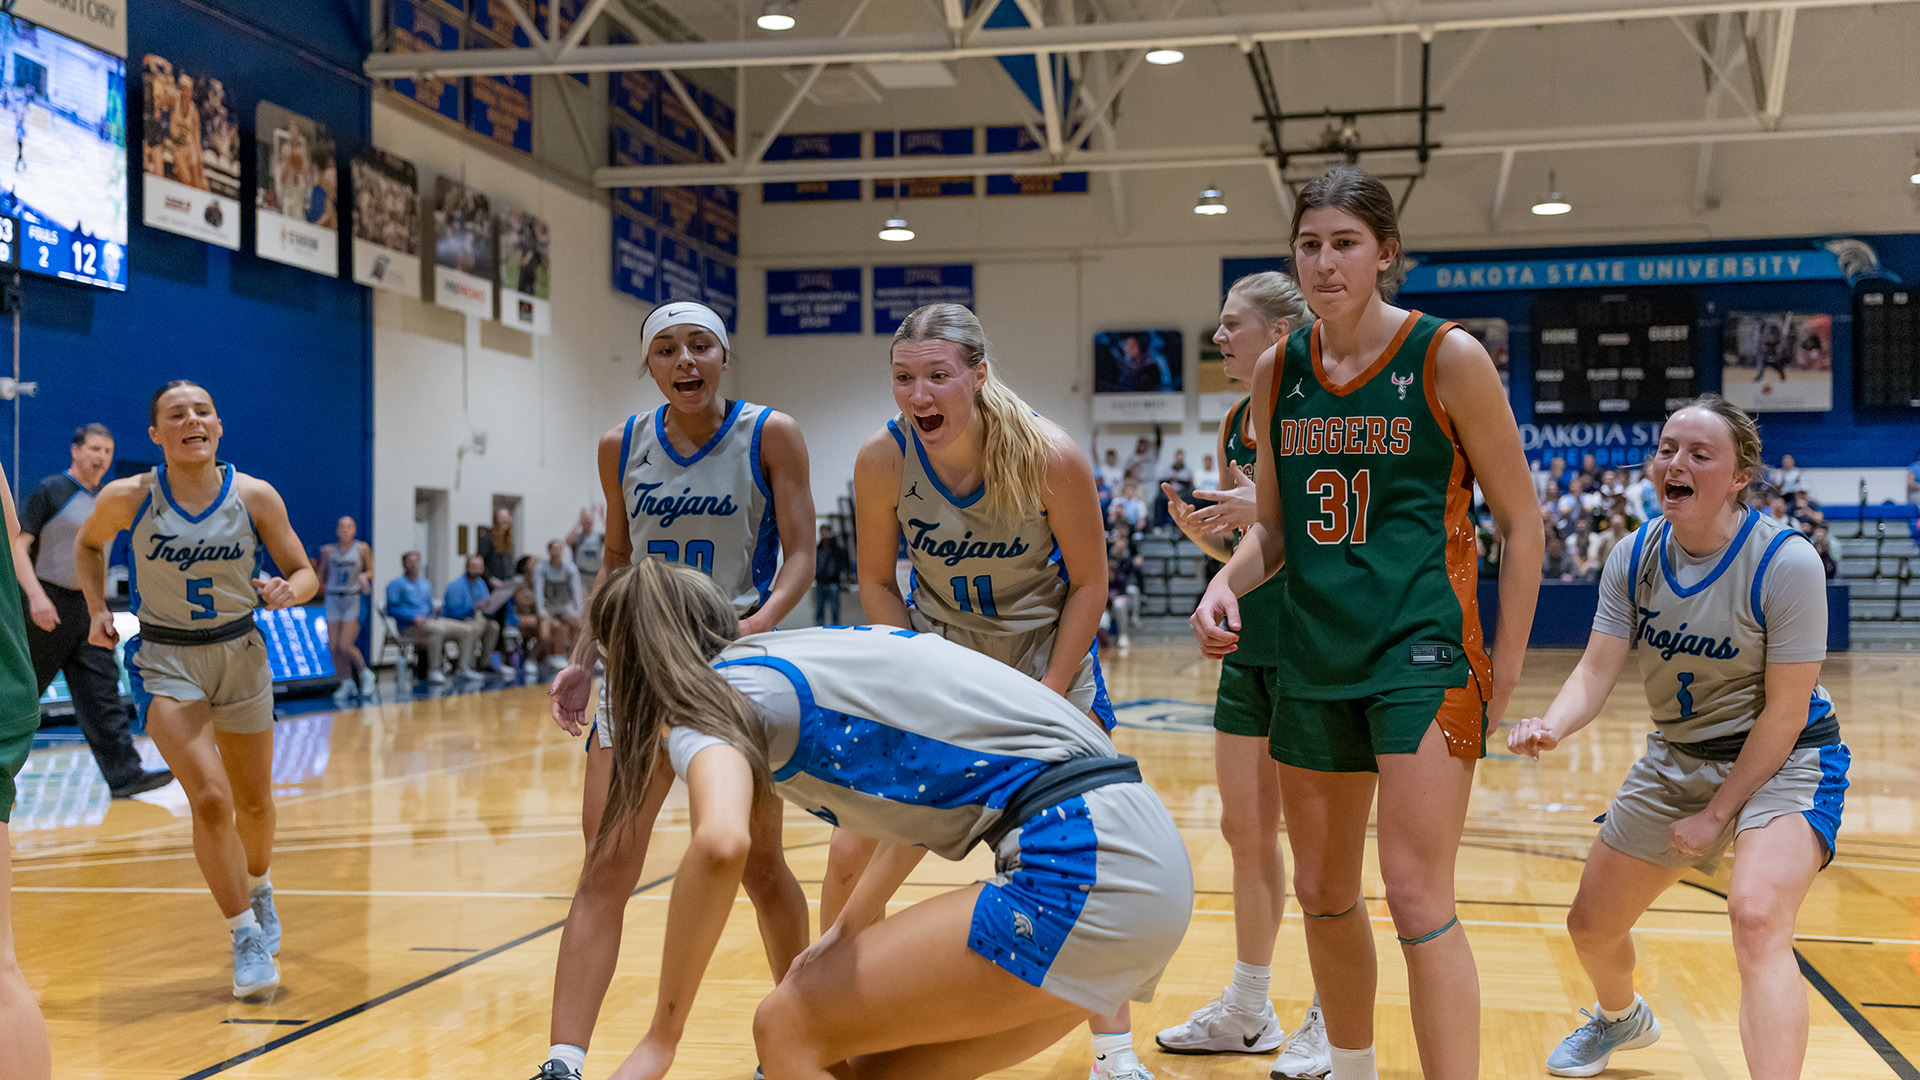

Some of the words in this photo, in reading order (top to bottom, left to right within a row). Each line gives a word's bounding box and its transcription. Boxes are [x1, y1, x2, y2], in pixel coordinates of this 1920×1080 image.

[38, 246, 49, 268] 2
[72, 240, 97, 276] 12
[1436, 265, 1535, 288] DAKOTA
[1547, 261, 1625, 285] STATE
[1638, 255, 1801, 281] UNIVERSITY
[1541, 328, 1578, 345] HOME
[1648, 325, 1690, 342] GUEST
[1280, 416, 1412, 457] DIGGERS
[1518, 423, 1627, 450] DAKOTA
[630, 481, 739, 529] Trojans
[1306, 469, 1370, 545] 31
[145, 533, 245, 572] Trojans
[908, 518, 1030, 566] Trojans
[186, 577, 218, 620] 5
[950, 575, 998, 618] 11
[1637, 606, 1741, 662] Trojans
[1441, 650, 1447, 659] L
[1676, 671, 1698, 722] 1
